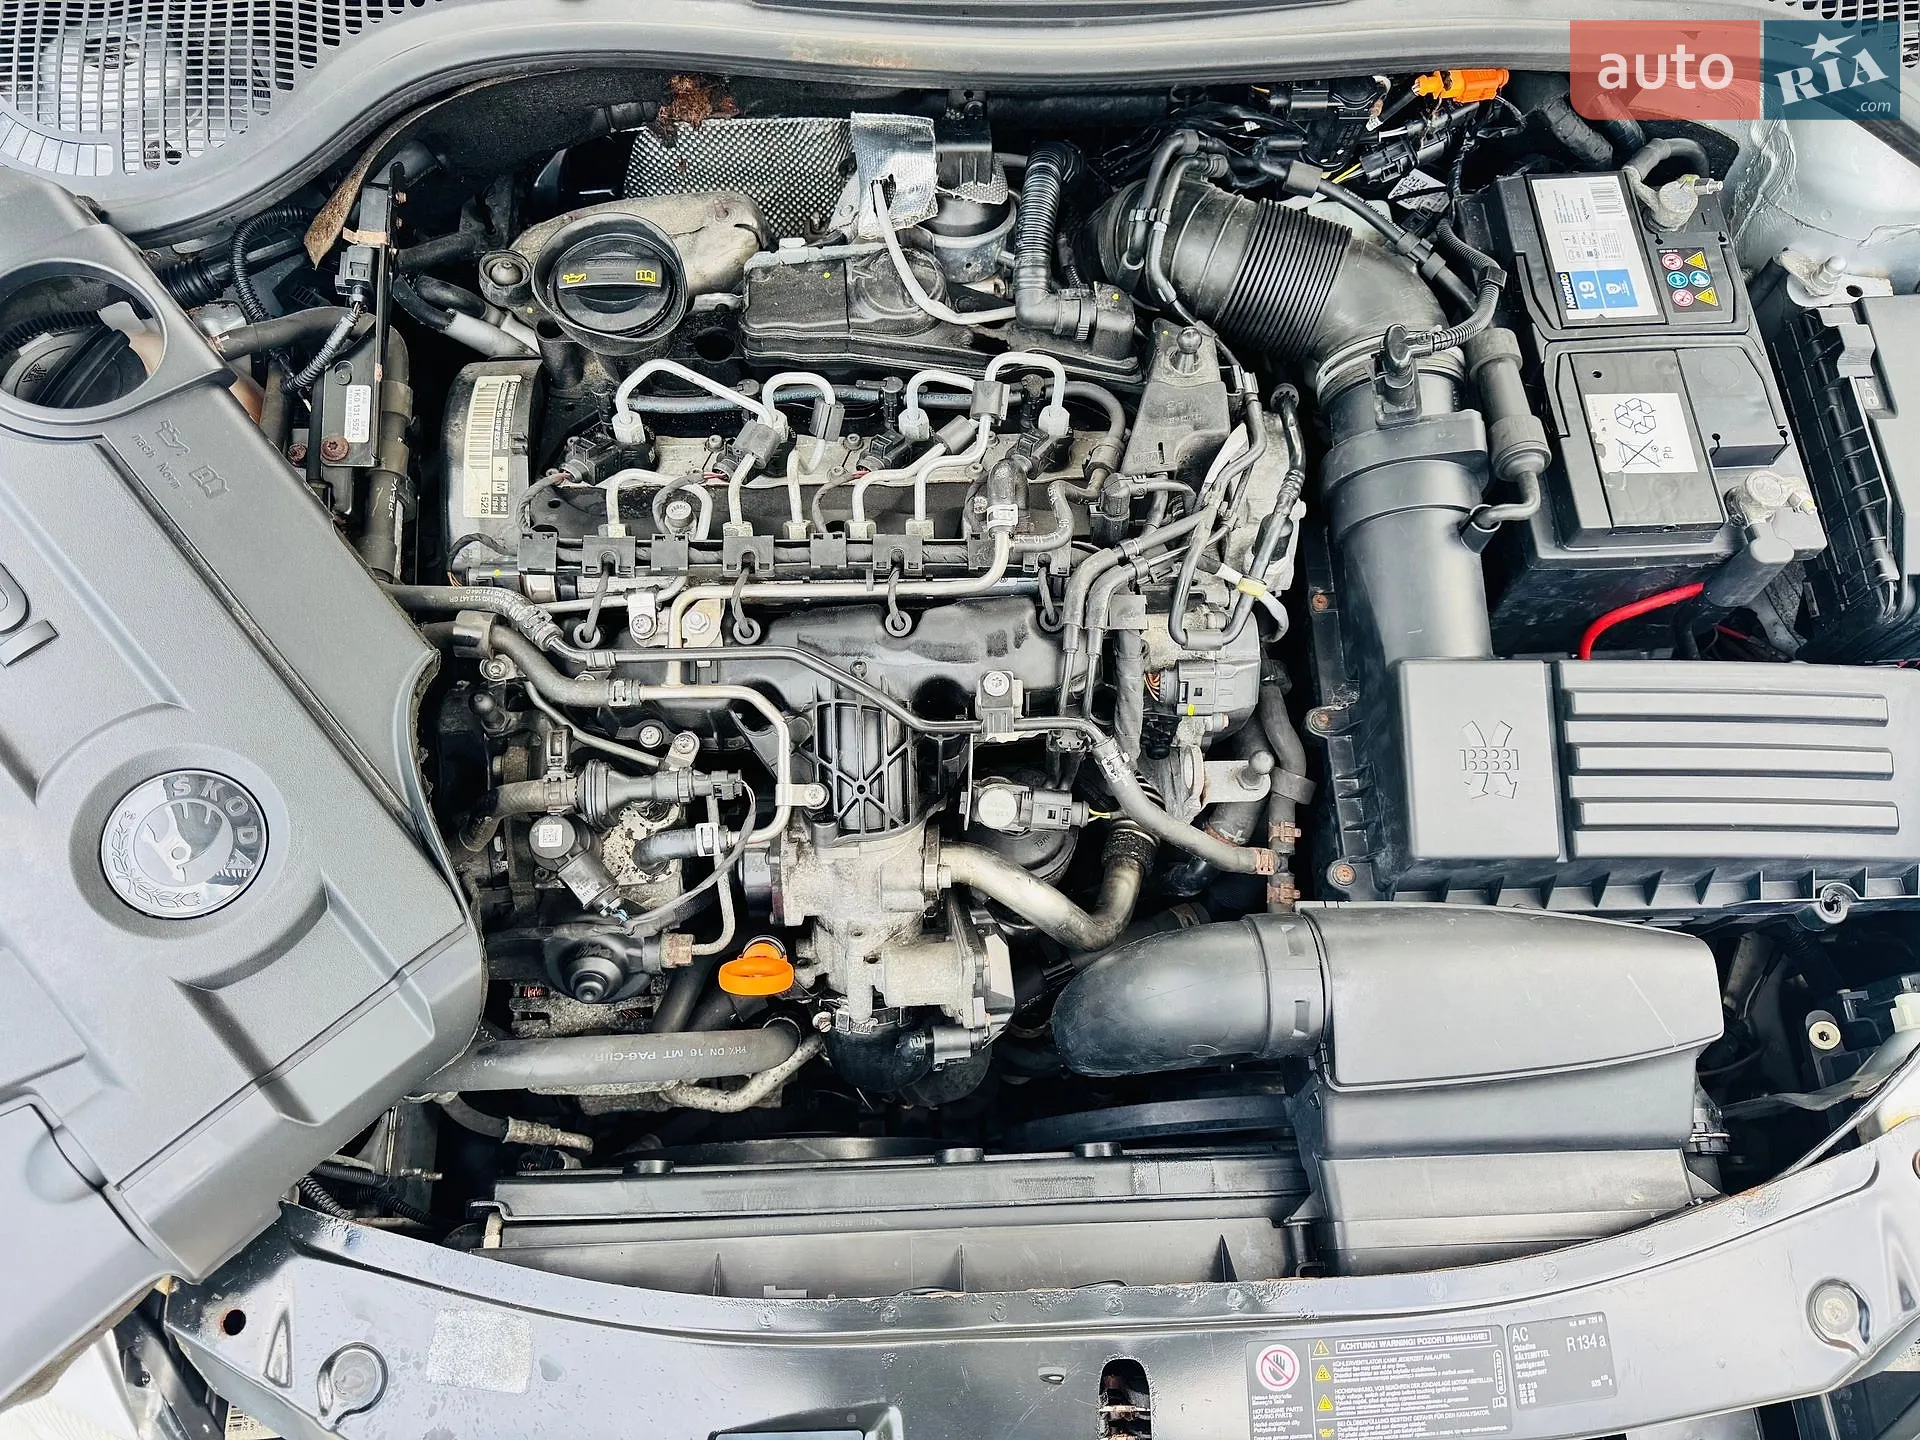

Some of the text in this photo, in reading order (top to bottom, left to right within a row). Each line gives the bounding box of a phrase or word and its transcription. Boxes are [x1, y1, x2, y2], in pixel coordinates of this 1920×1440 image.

[1579, 281, 1597, 300] 19
[1662, 446, 1675, 460] Pb
[480, 492, 489, 515] 1528
[664, 1049, 683, 1059] MT
[690, 1048, 703, 1057] 16
[710, 1047, 725, 1056] DN
[1512, 1327, 1529, 1342] AC
[1340, 1336, 1444, 1351] ACHTUNG! WARNING! POZOR!
[1566, 1333, 1607, 1352] R 134 a
